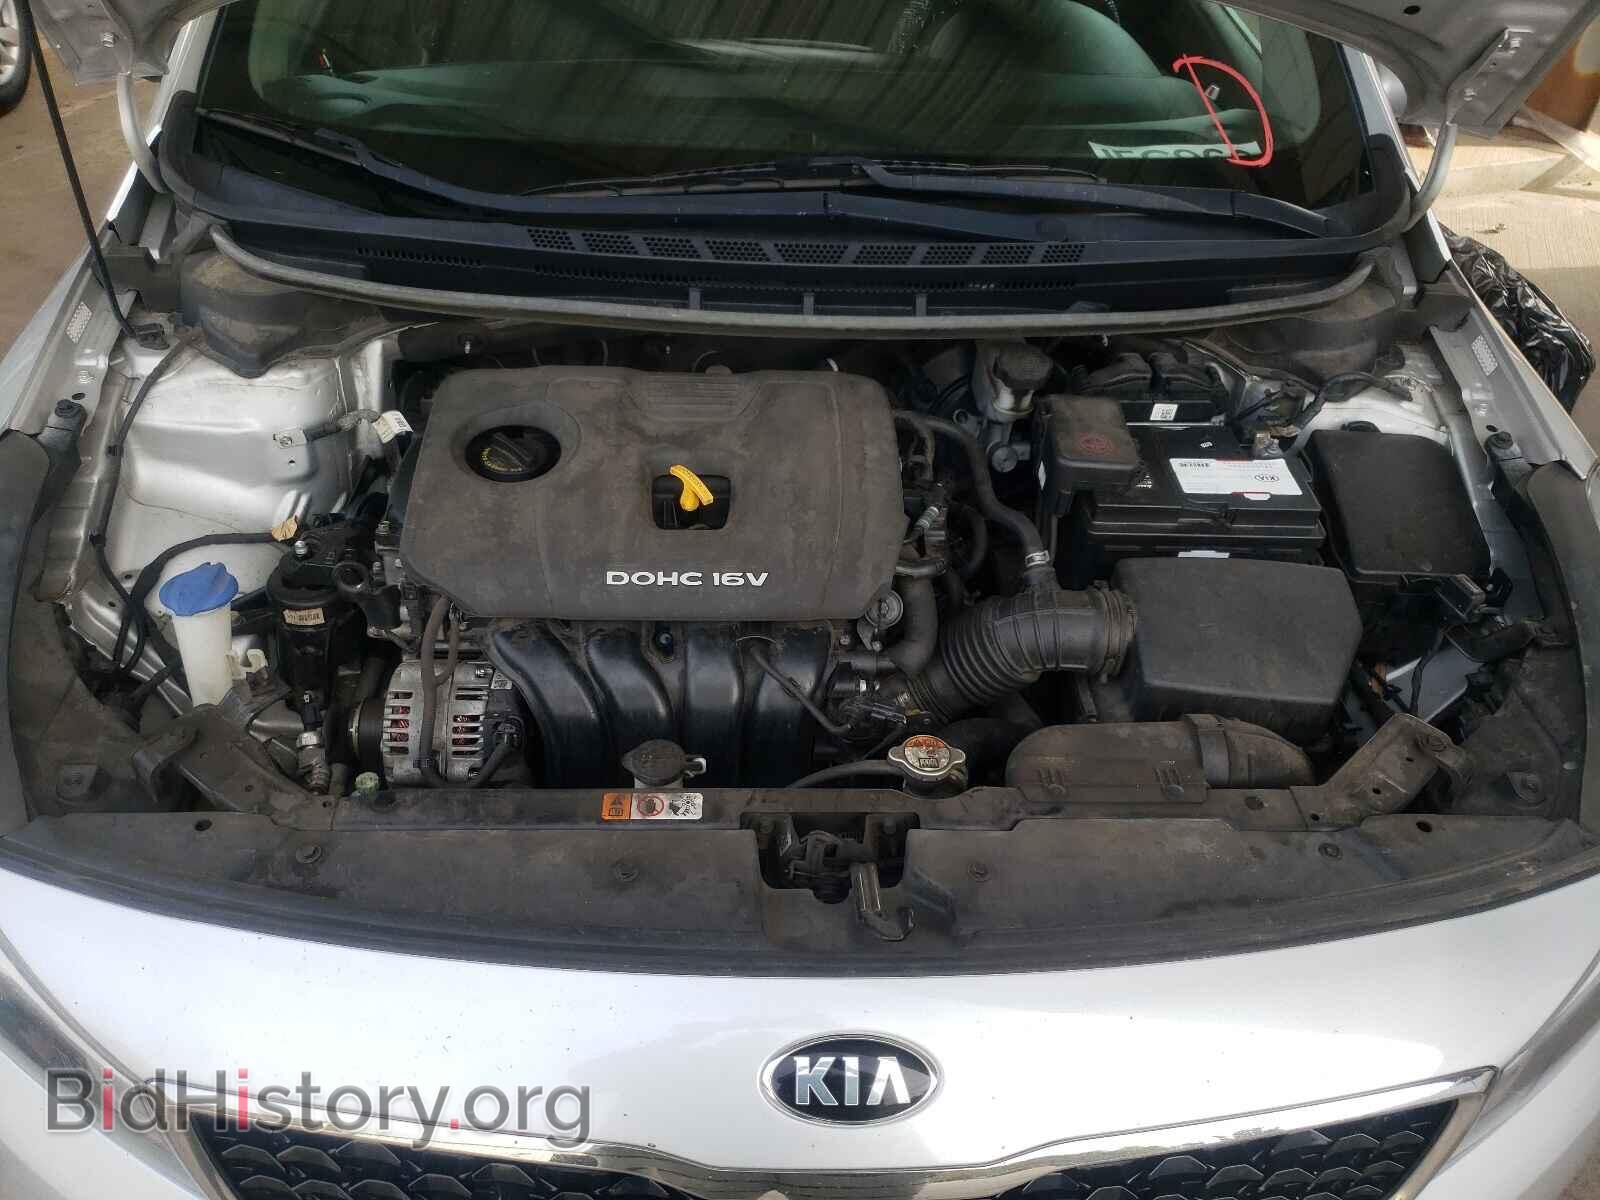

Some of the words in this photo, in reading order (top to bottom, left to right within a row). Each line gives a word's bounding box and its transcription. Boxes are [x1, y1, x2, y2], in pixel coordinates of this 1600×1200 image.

[606, 571, 703, 586] DOHC
[712, 572, 769, 587] 16V
[793, 1056, 911, 1106] KIA
